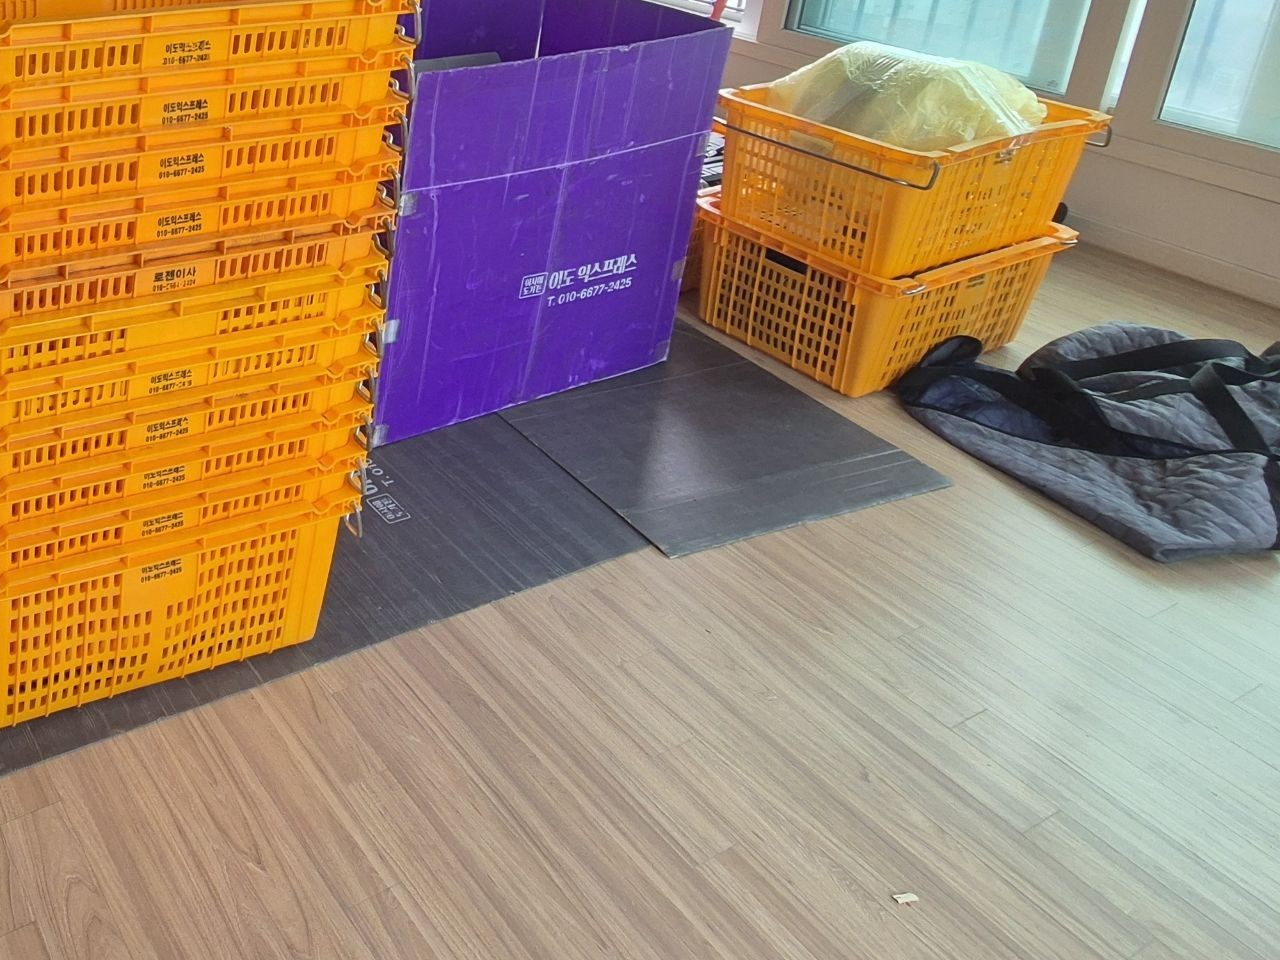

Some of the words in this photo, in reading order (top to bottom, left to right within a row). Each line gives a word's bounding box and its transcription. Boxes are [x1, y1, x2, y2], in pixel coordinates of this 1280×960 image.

[163, 99, 208, 113] 이도익스프레스
[160, 153, 204, 168] 이도익스프레스
[159, 166, 204, 179] 010-6677-2425
[158, 212, 202, 227] 이도익스프레스
[157, 223, 201, 237] 010-6677-2425
[153, 266, 196, 282] 로젠이사
[549, 268, 576, 289] 이도
[578, 253, 637, 282] 익스프레스
[547, 296, 556, 307] T.
[558, 277, 632, 304] 010-6677-2425
